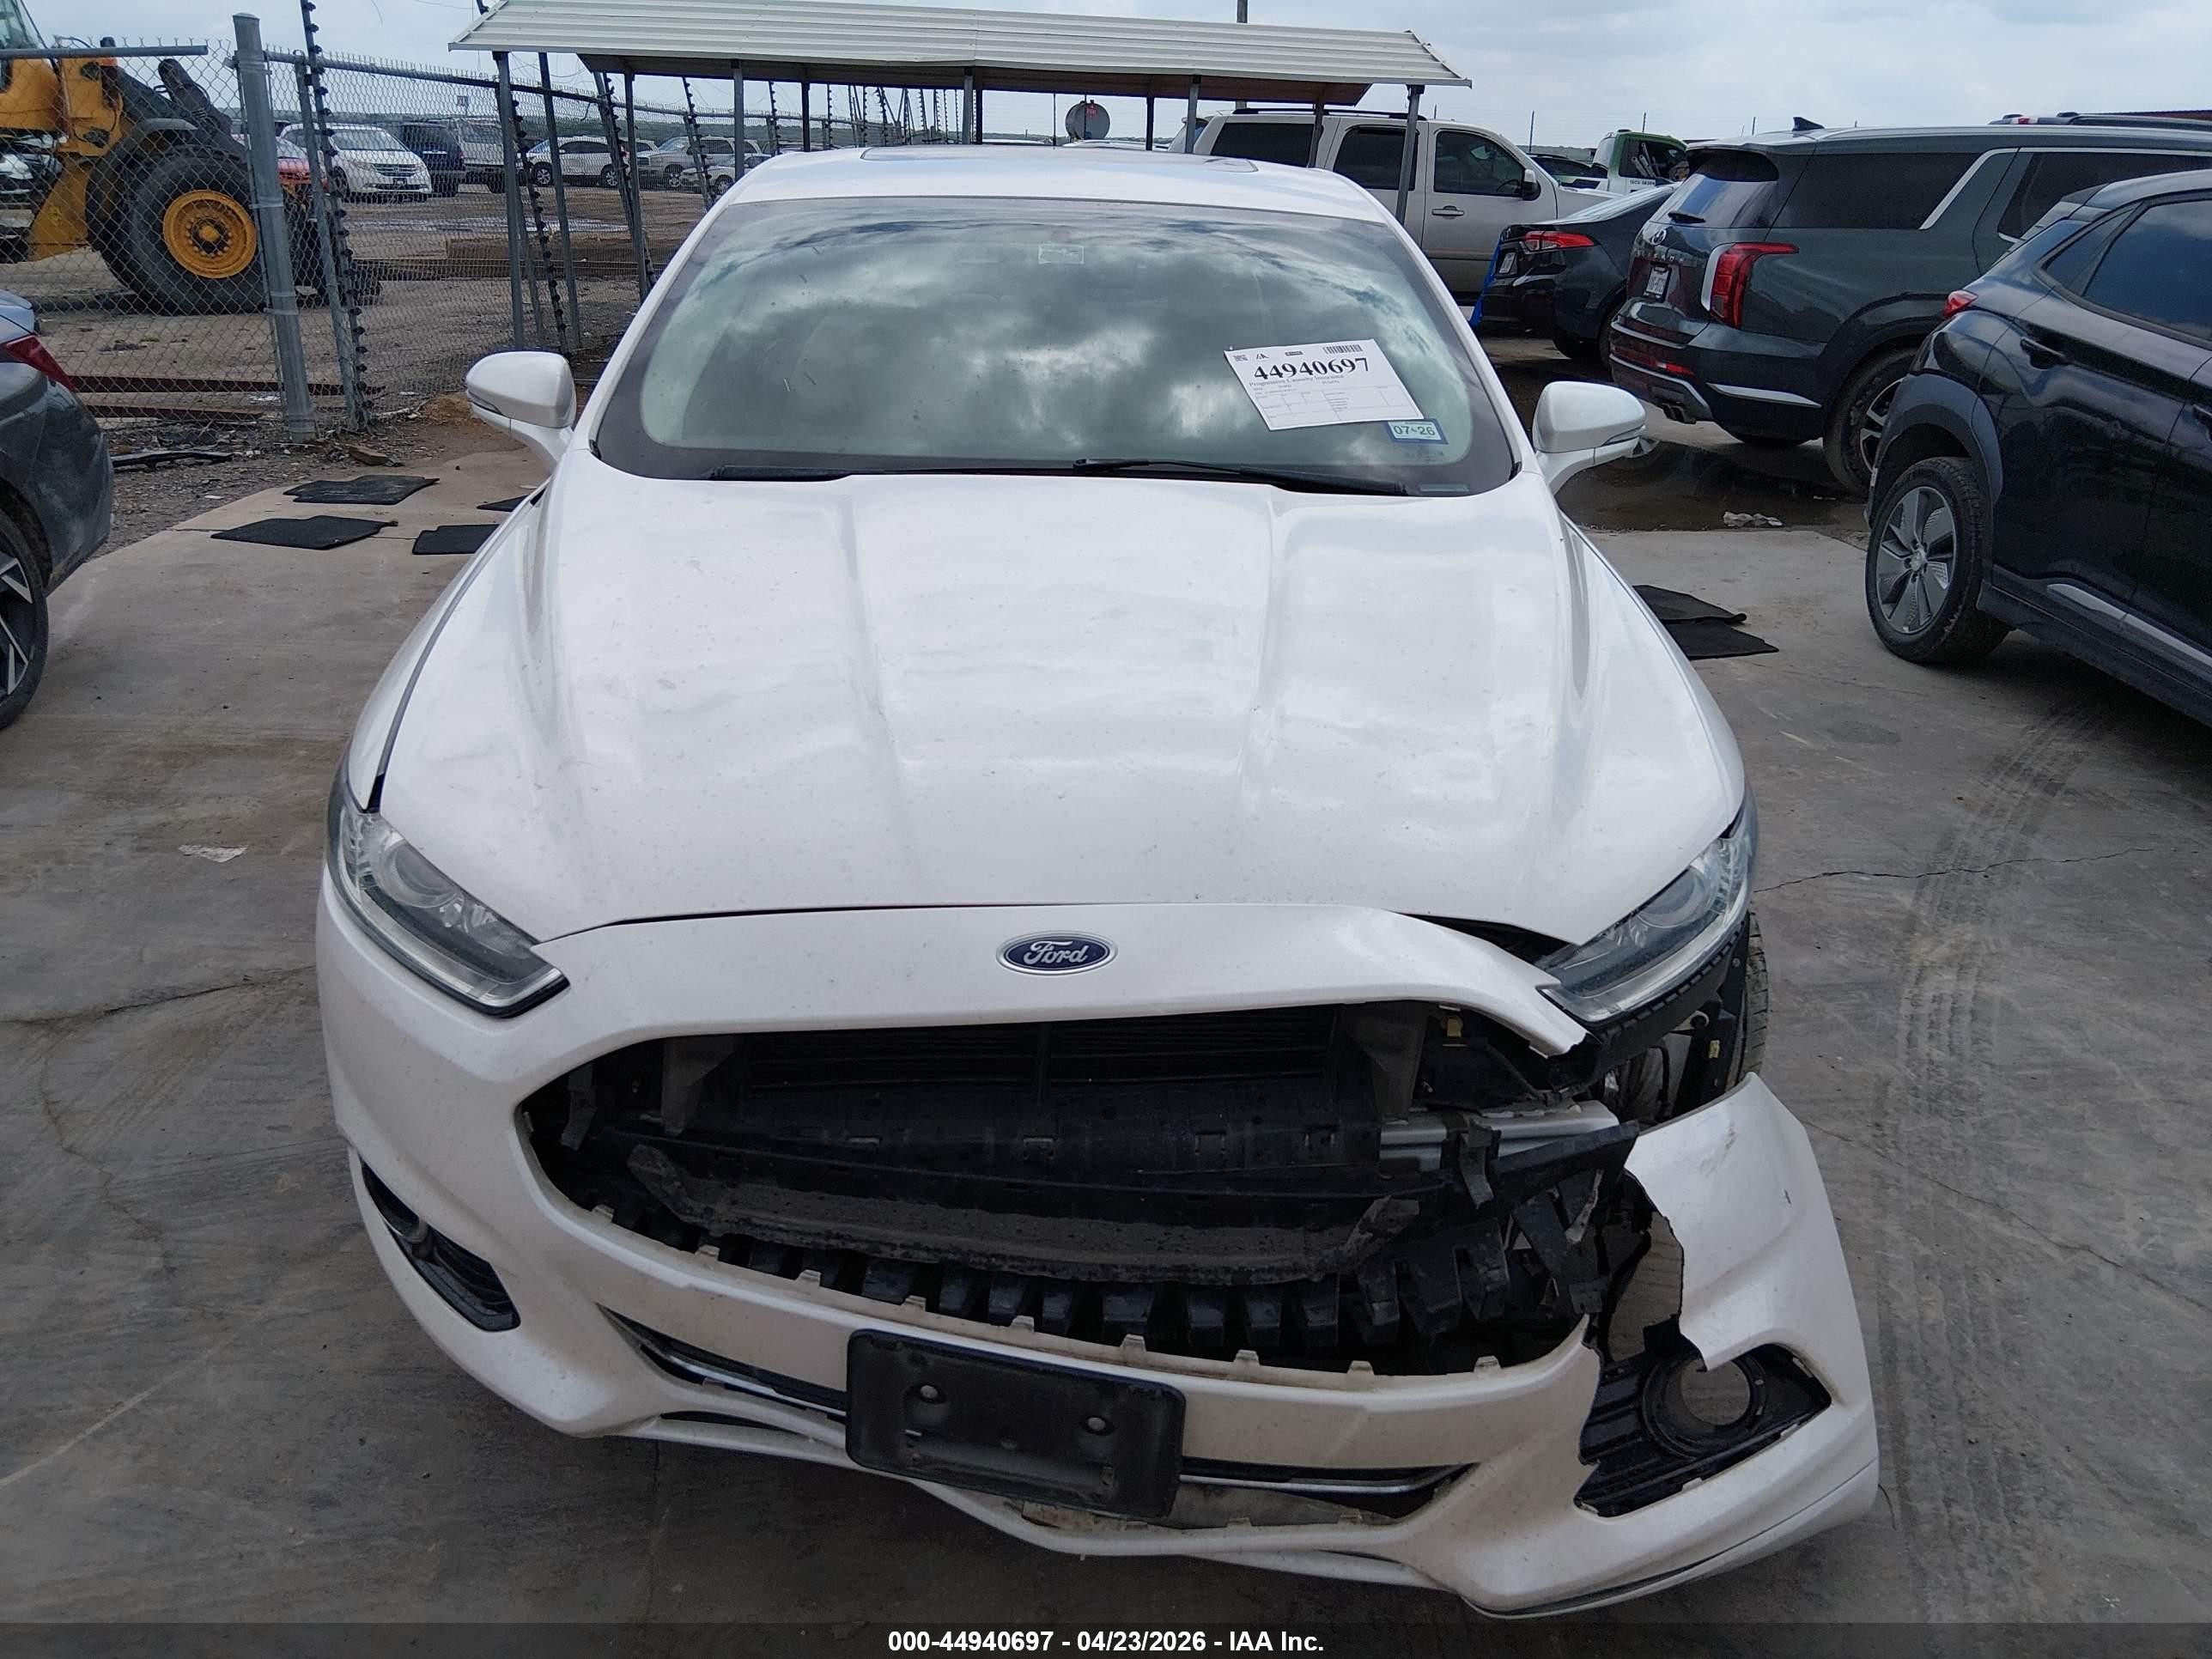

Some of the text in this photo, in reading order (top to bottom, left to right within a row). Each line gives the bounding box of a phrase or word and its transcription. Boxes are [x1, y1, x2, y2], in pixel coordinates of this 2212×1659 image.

[1255, 357, 1368, 380] 44940697
[1393, 425, 1436, 436] 07 26
[1023, 940, 1090, 964] Ford
